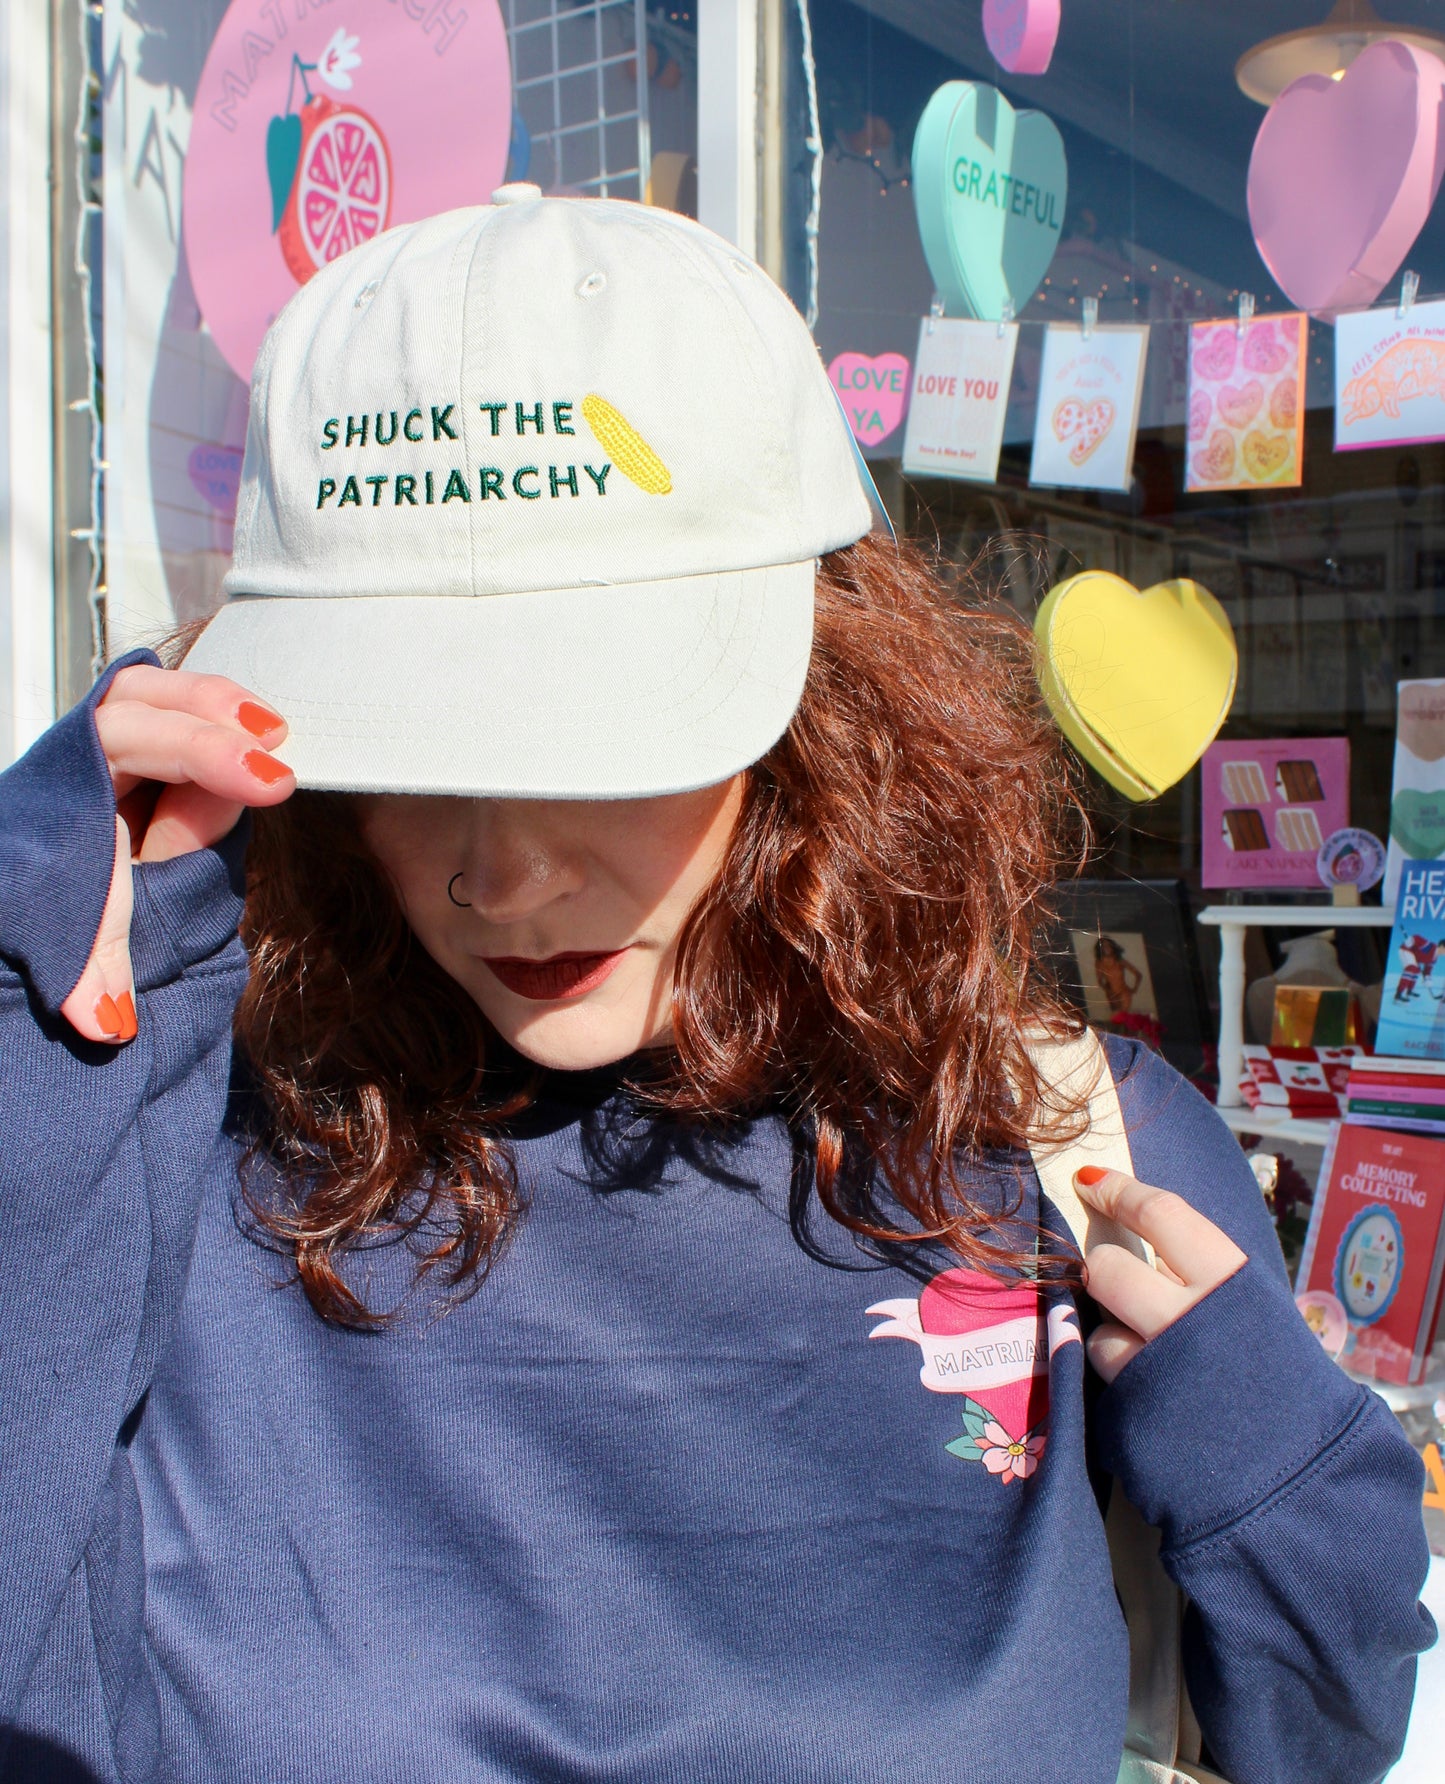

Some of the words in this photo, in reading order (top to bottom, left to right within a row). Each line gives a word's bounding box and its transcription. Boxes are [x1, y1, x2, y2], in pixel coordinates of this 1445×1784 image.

[953, 156, 1058, 230] GRATEFUL
[838, 367, 903, 392] LOVE
[917, 374, 957, 396] LOVE
[963, 378, 999, 401] YOU
[321, 404, 458, 450] SHUCK
[480, 401, 575, 436] THE
[853, 408, 885, 432] YA
[317, 464, 612, 509] PATRIARCHY
[1264, 858, 1317, 871] NAPKIN
[1406, 870, 1445, 895] HE
[1402, 895, 1445, 920] RIV
[1356, 1161, 1418, 1188] MEMORY
[1340, 1174, 1427, 1208] COLLECTING
